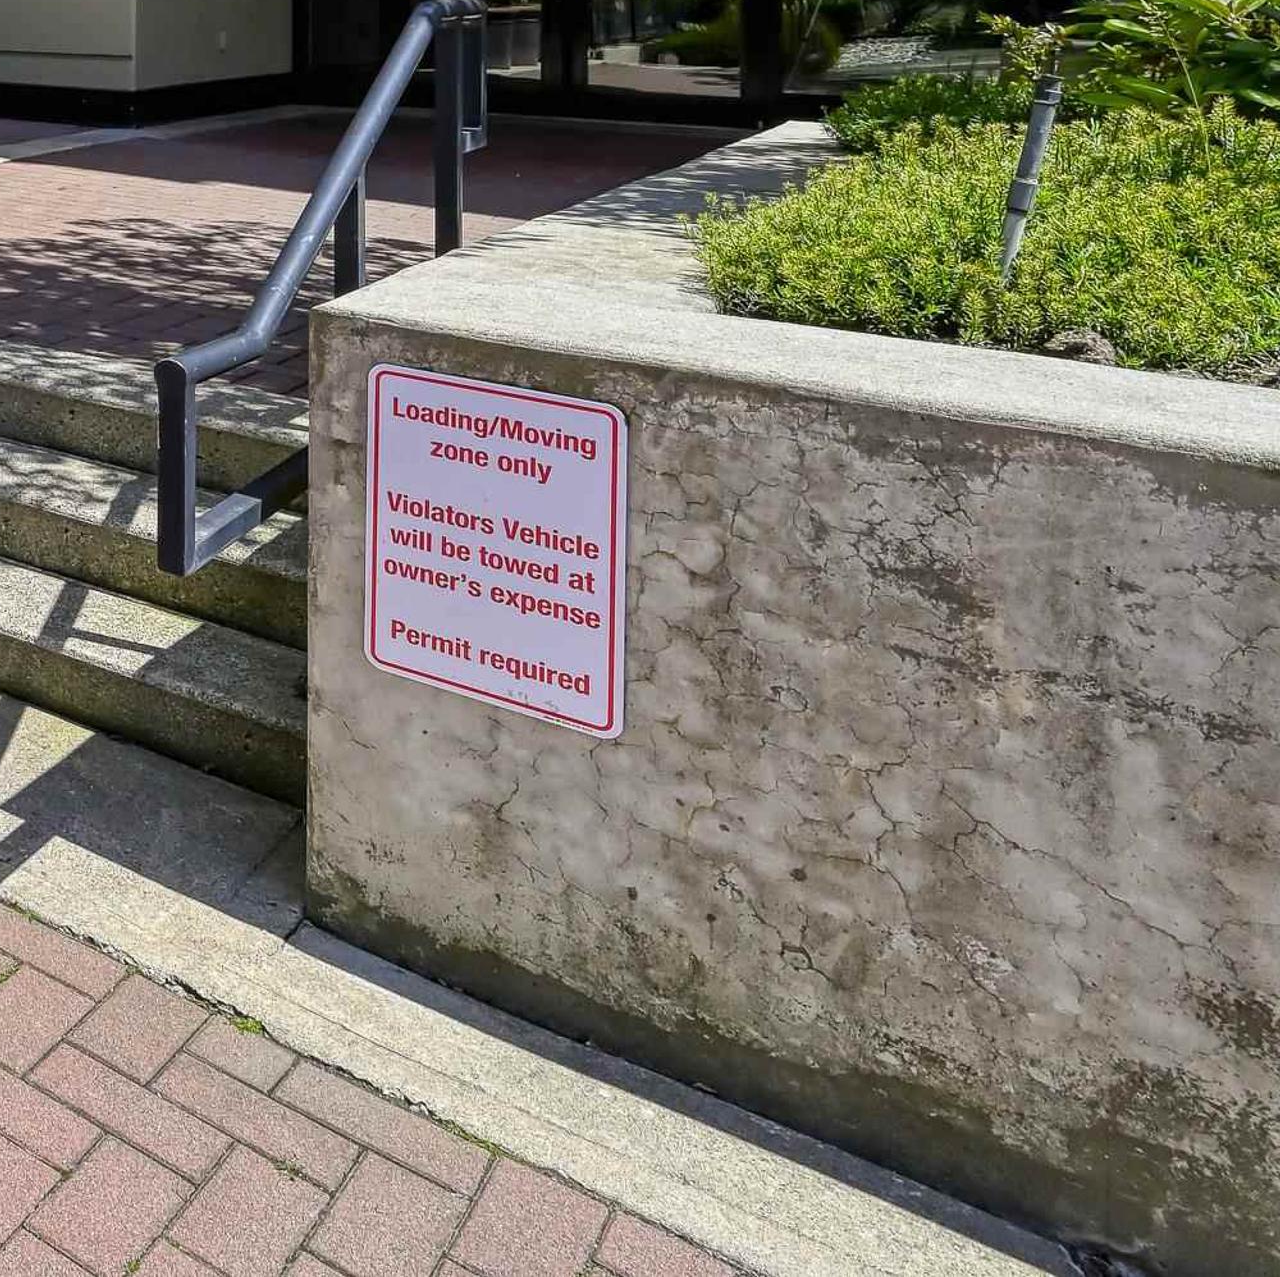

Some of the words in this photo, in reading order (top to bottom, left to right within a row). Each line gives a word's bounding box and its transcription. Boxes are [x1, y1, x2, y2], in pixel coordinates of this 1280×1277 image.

[392, 397, 597, 460] Loading/Moving
[430, 440, 489, 467] zone
[498, 454, 552, 484] only
[387, 490, 494, 535] Violators
[502, 517, 600, 560] Vehicle
[383, 558, 482, 598] owner's
[490, 585, 601, 629] expense
[390, 527, 432, 553] will
[441, 535, 471, 562] be
[478, 545, 559, 584] towed
[568, 570, 596, 595] at
[390, 618, 472, 661] Permit
[479, 648, 591, 696] required
